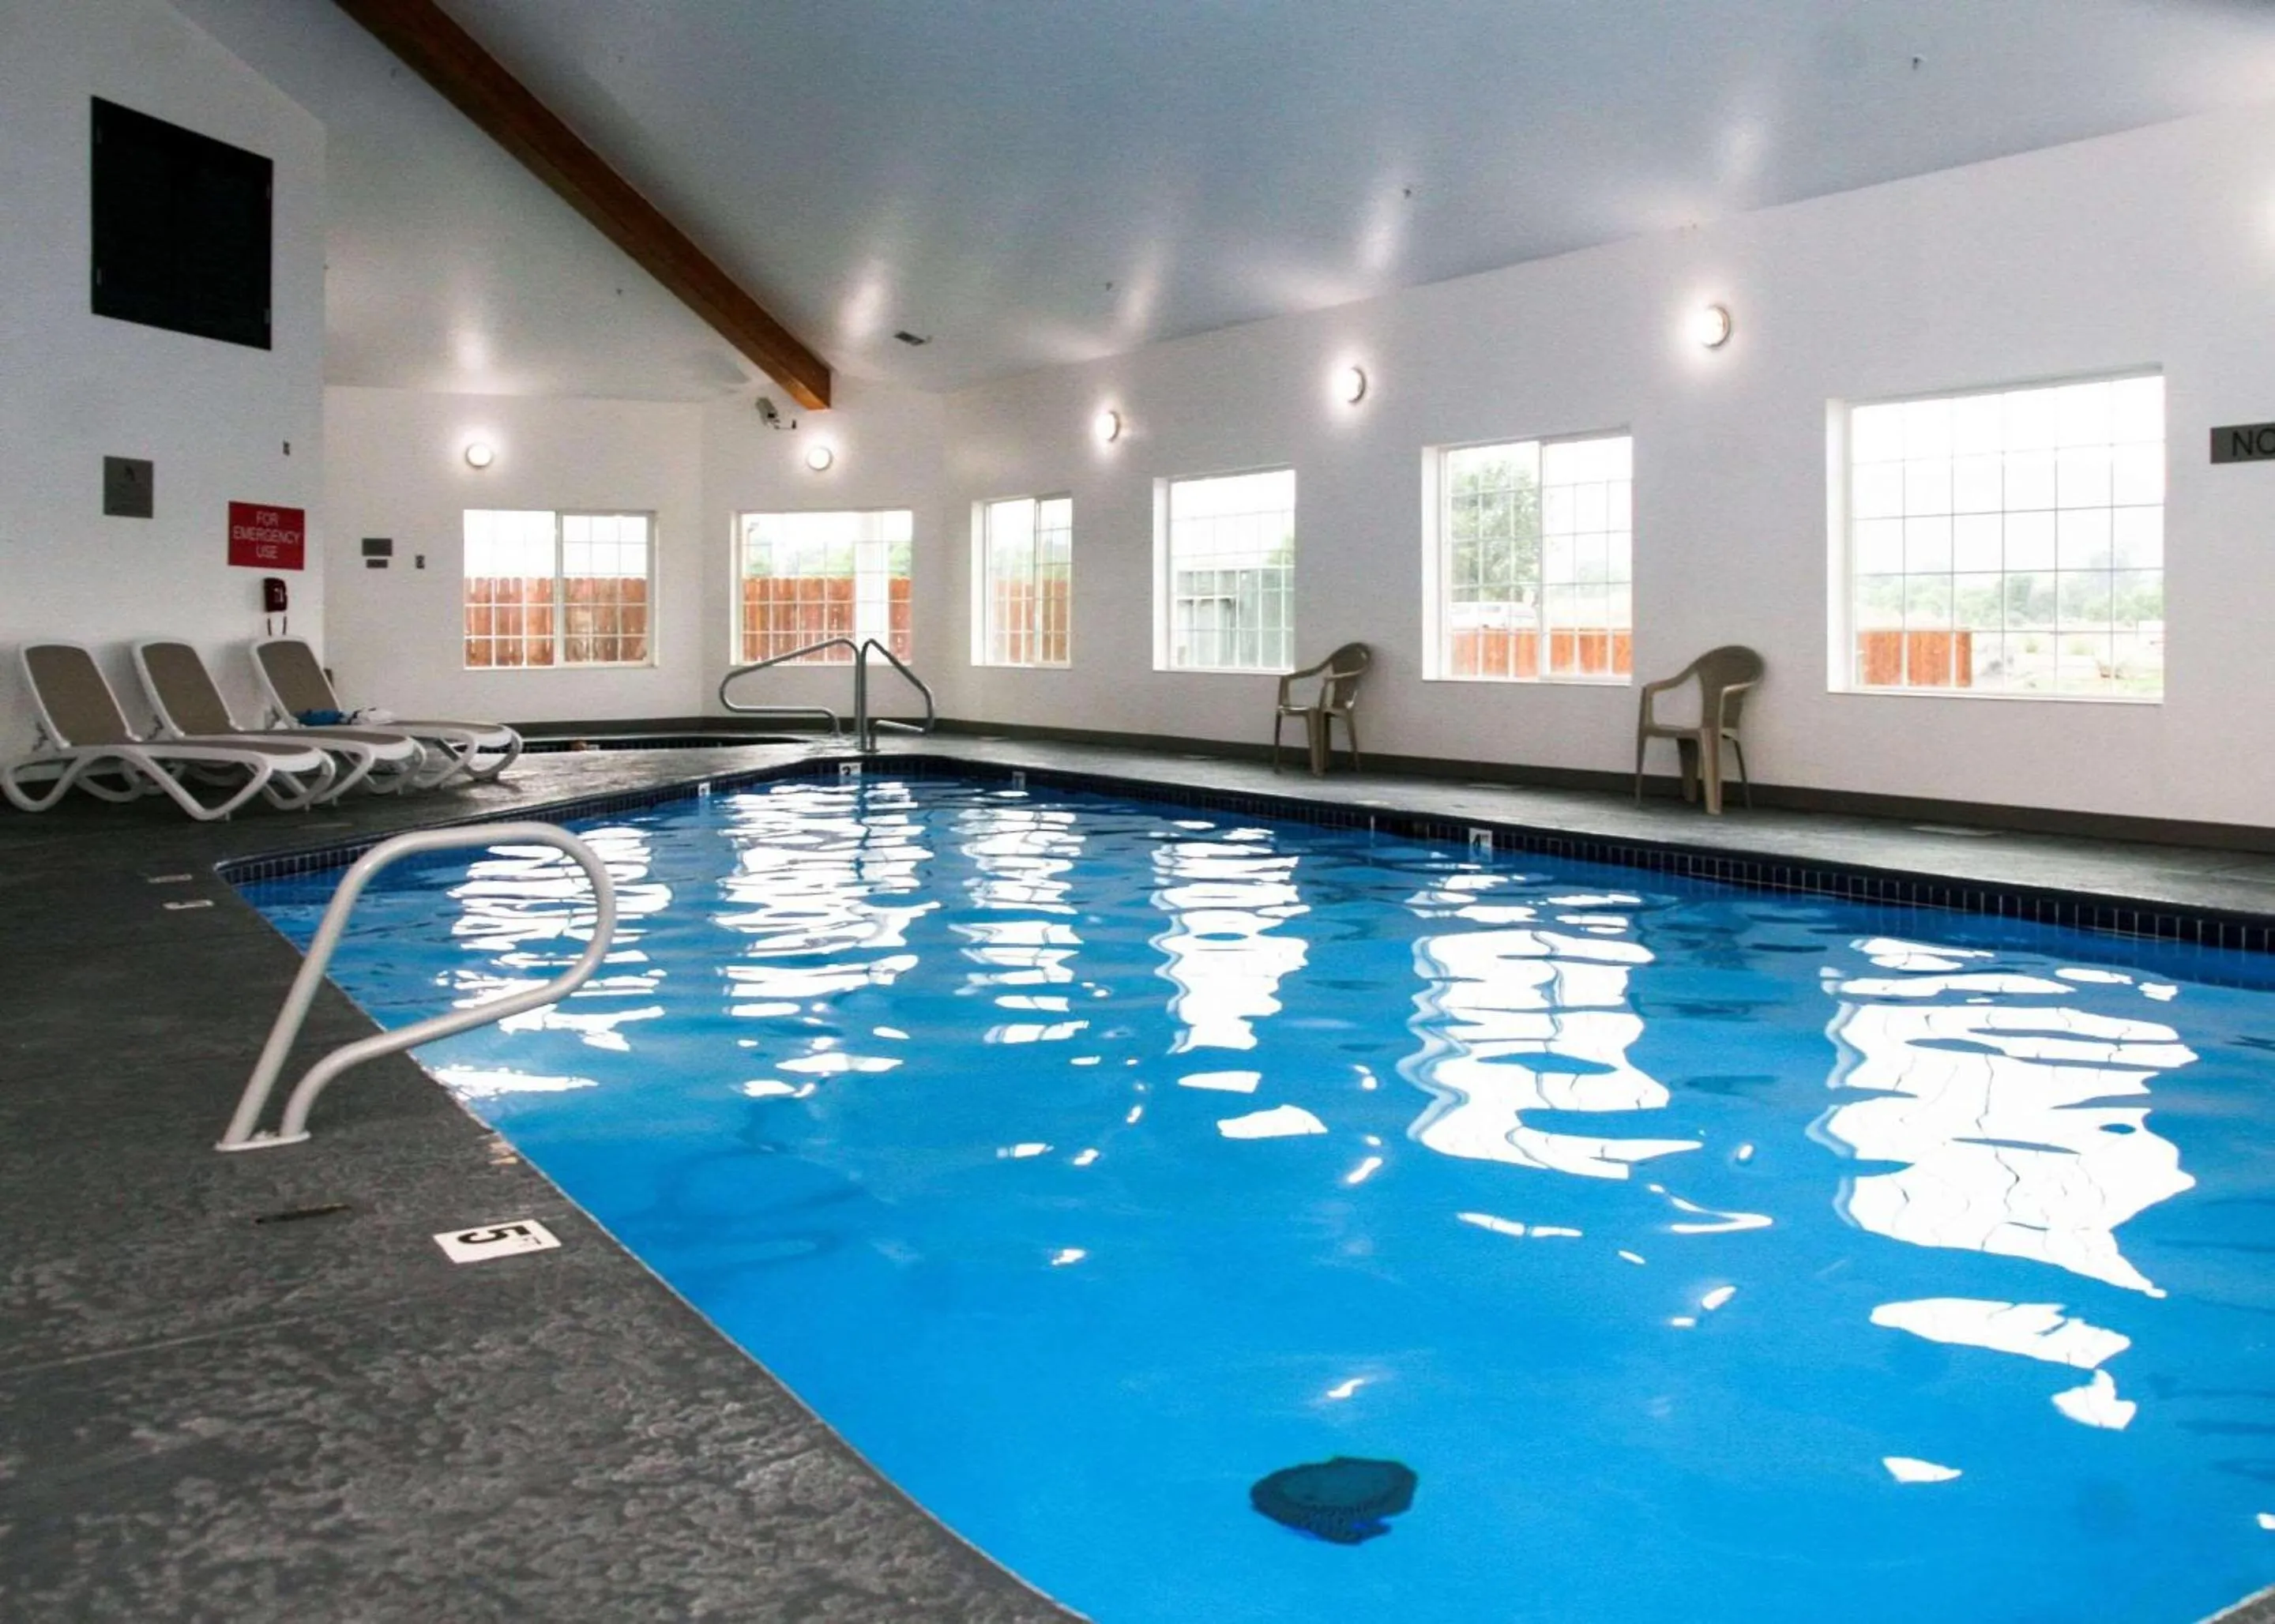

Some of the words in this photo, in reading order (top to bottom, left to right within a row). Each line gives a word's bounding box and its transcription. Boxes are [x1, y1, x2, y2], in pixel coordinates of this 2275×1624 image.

[2232, 428, 2275, 457] NO
[256, 510, 278, 527] FOR
[233, 524, 299, 544] EMERGENCY
[256, 545, 278, 559] USE
[457, 1225, 531, 1244] 5
